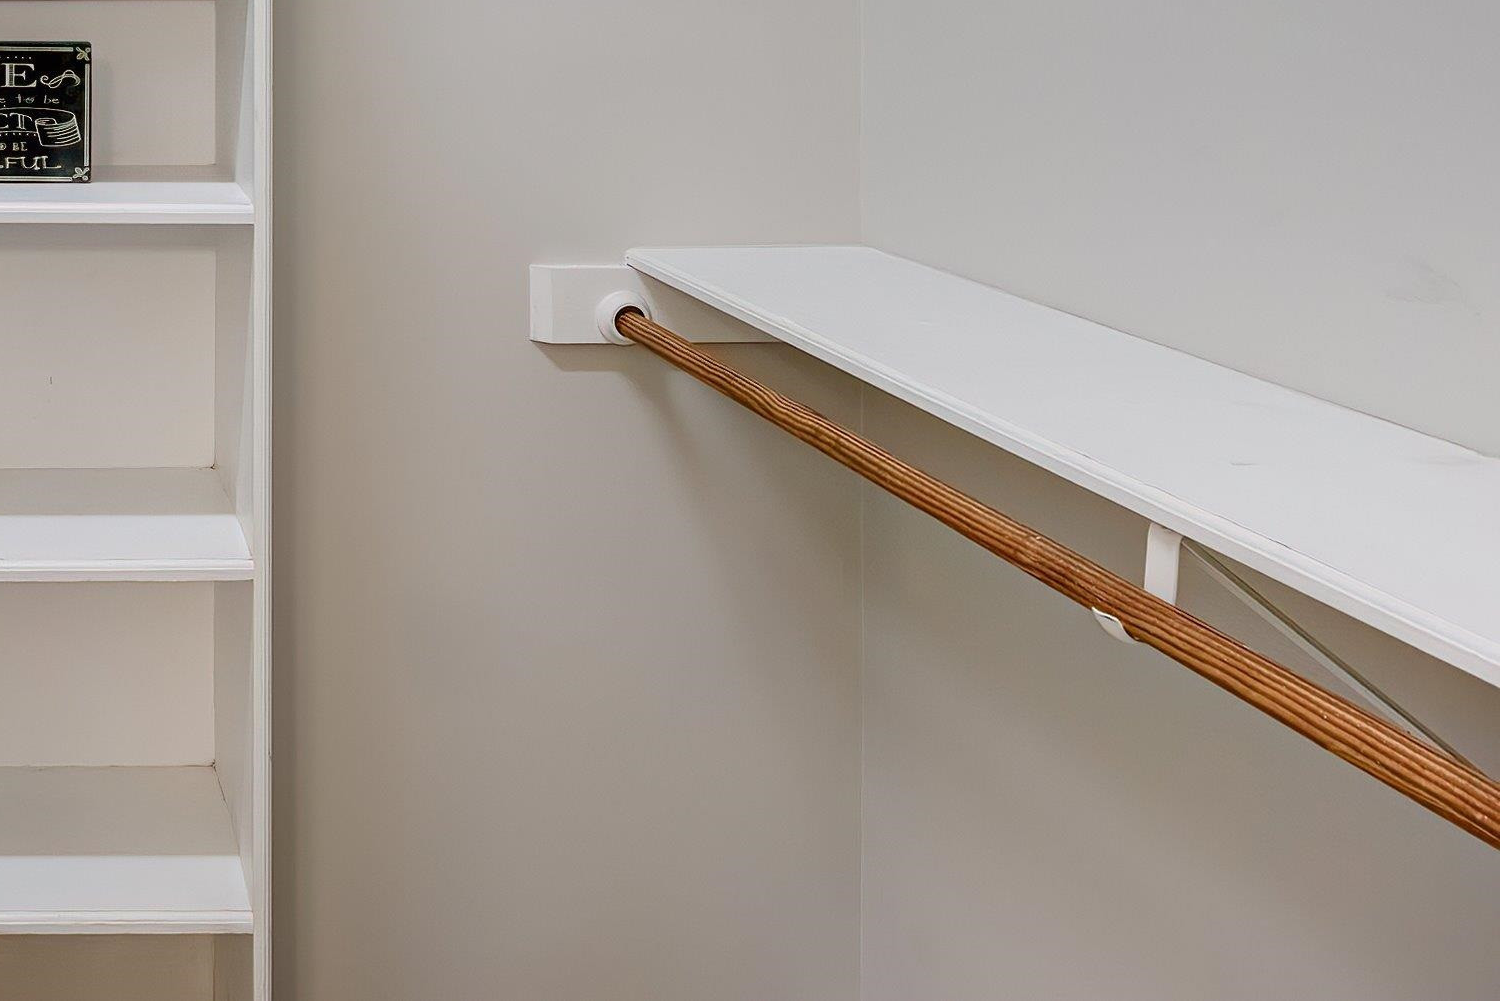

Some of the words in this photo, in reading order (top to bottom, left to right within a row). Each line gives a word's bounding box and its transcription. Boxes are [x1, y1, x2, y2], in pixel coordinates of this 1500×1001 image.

[15, 93, 35, 104] to
[43, 94, 60, 104] be
[12, 142, 28, 151] BE
